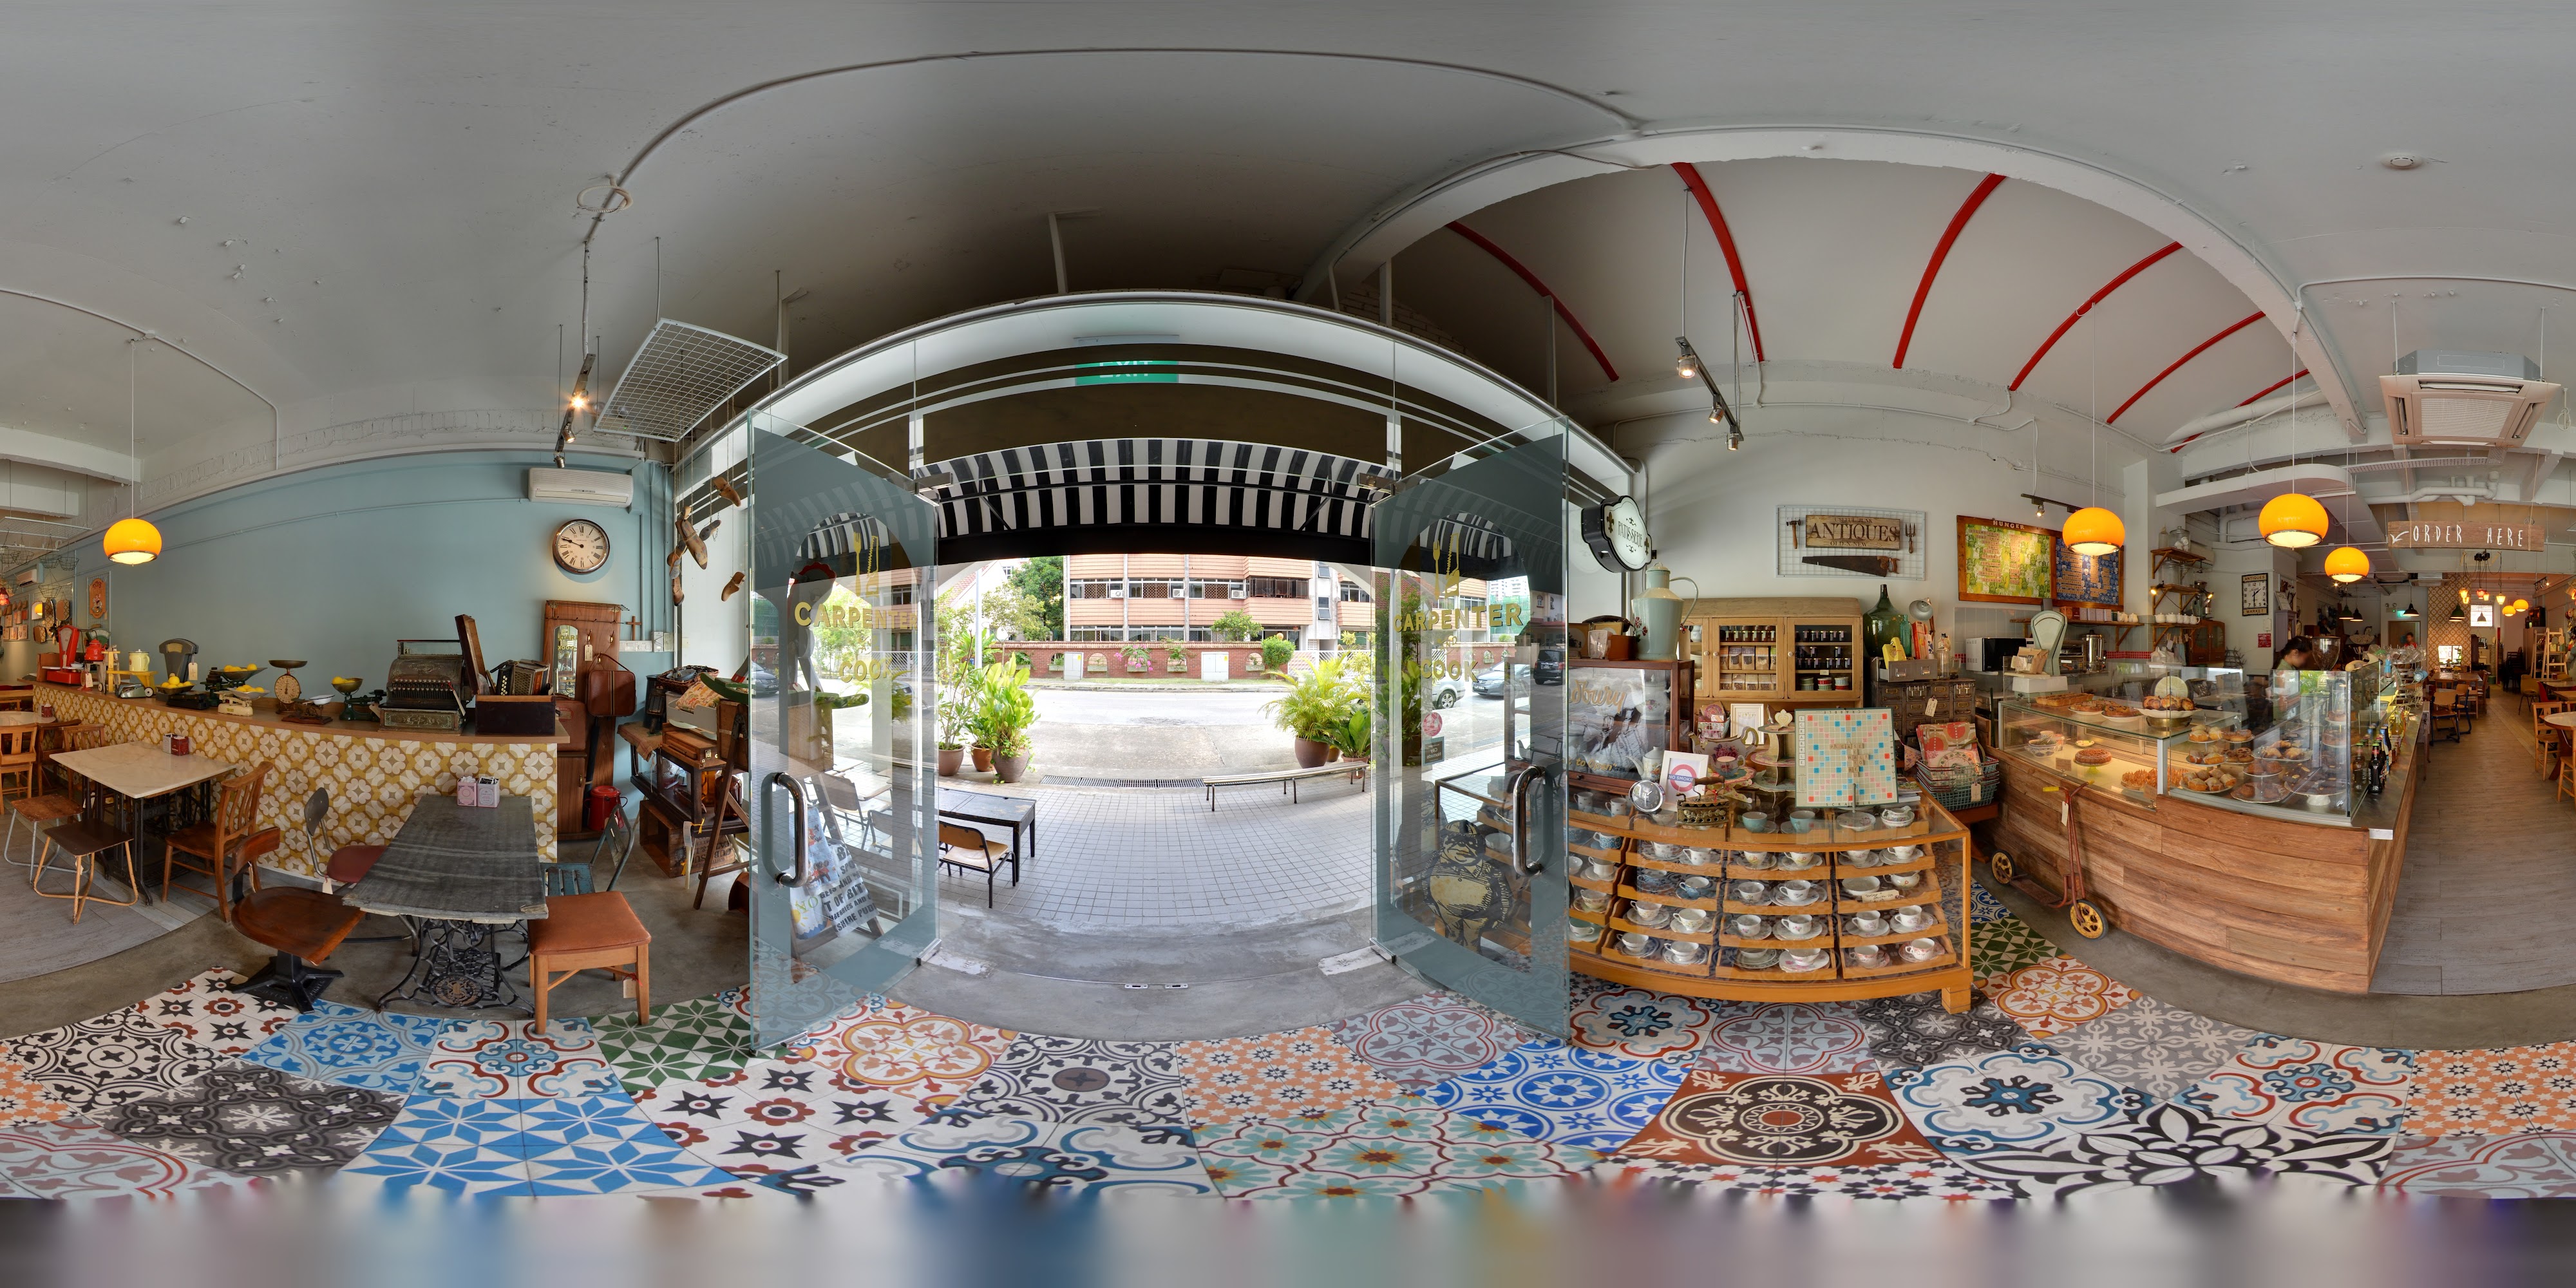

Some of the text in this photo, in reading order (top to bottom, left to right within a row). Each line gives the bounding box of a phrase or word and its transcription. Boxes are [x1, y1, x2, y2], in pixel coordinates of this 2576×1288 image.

[1618, 521, 1643, 547] PATISSERIE
[1808, 523, 1897, 542] ANTIQUES
[1993, 520, 2025, 529] HUNGER
[2413, 524, 2523, 547] ORDER HERE
[795, 601, 918, 630] CARPENTER
[1394, 603, 1523, 632] CARPENTER
[838, 657, 893, 683] COOK
[1421, 659, 1479, 683] COOK
[1569, 679, 1627, 715] dbury
[840, 860, 856, 875] SPO
[834, 893, 844, 907] OF
[847, 882, 864, 900] BIT
[829, 903, 853, 921] NBERRIES
[855, 896, 867, 906] AND
[835, 902, 876, 932] SHIRE PUD
